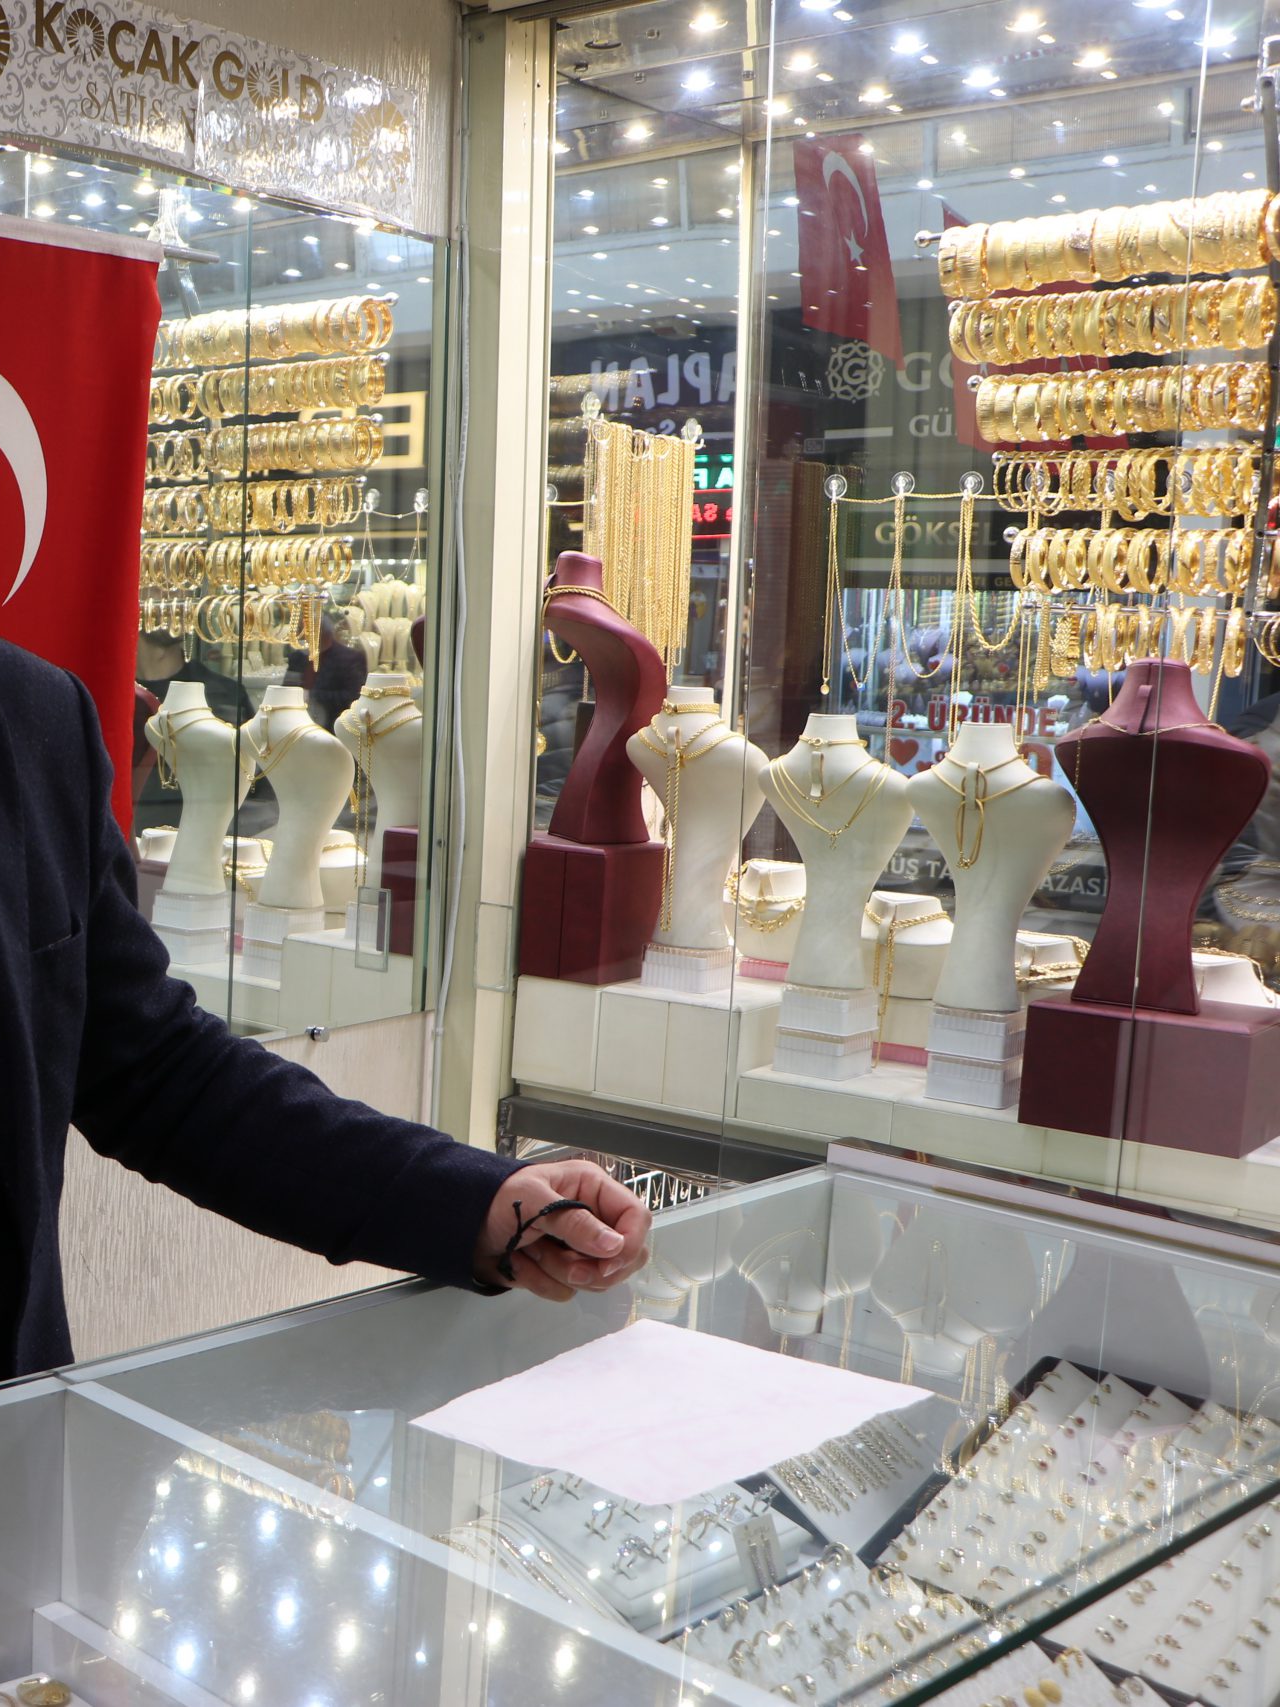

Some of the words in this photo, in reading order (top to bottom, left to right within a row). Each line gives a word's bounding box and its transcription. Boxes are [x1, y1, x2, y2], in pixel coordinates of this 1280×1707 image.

[212, 50, 324, 122] GOLD
[874, 515, 998, 546] GÖKSEL
[945, 574, 986, 587] KTI
